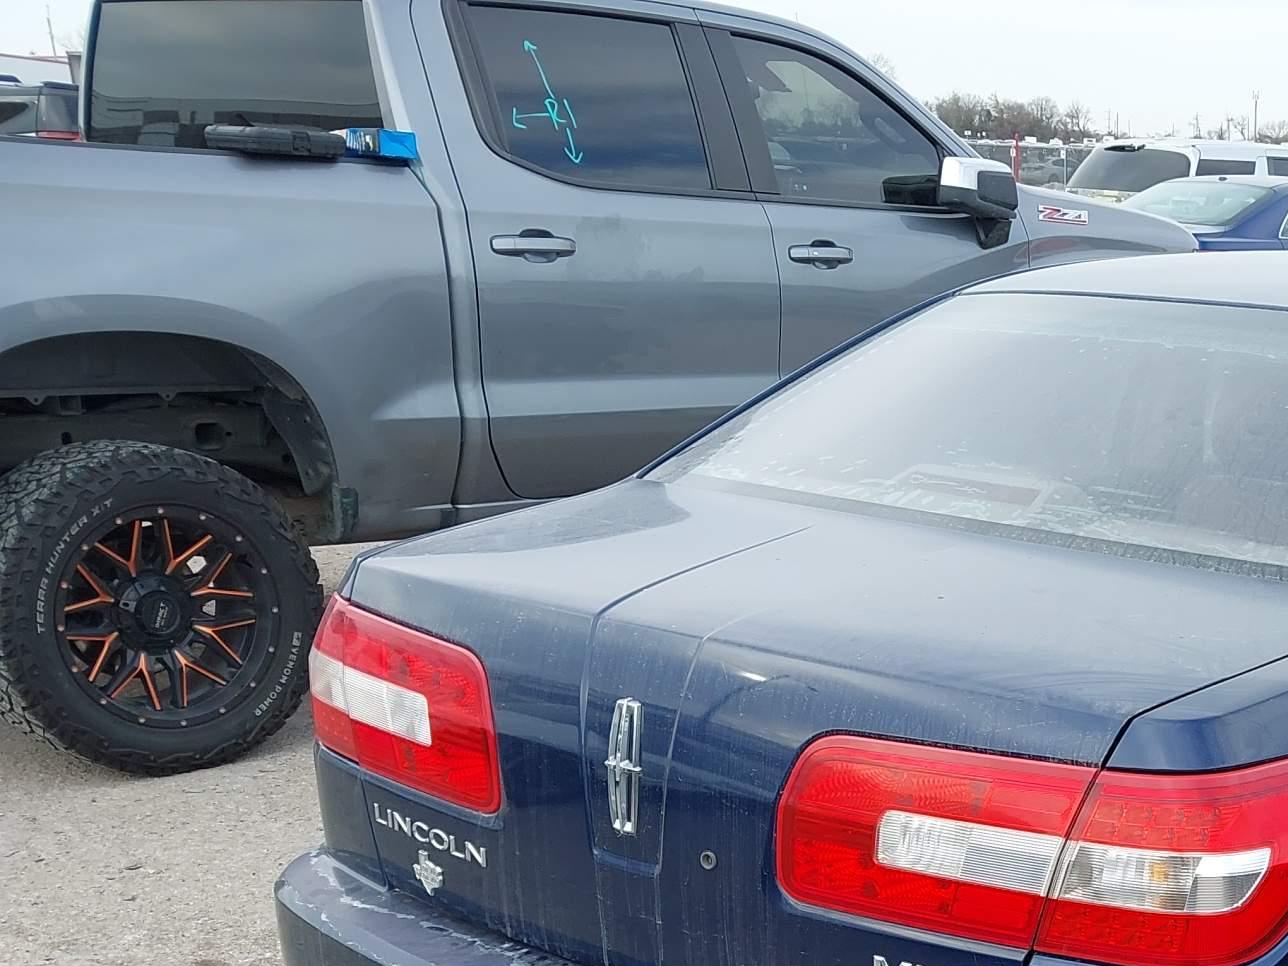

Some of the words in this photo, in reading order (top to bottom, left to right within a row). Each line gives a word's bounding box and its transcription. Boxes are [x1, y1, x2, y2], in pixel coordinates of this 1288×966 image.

[1038, 204, 1088, 225] Z71
[35, 577, 49, 635] TERRA
[45, 515, 89, 575] HUNTER
[91, 498, 113, 517] X/T
[280, 647, 300, 684] VENOM
[253, 684, 283, 717] POWER
[373, 803, 487, 869] LINCOLN
